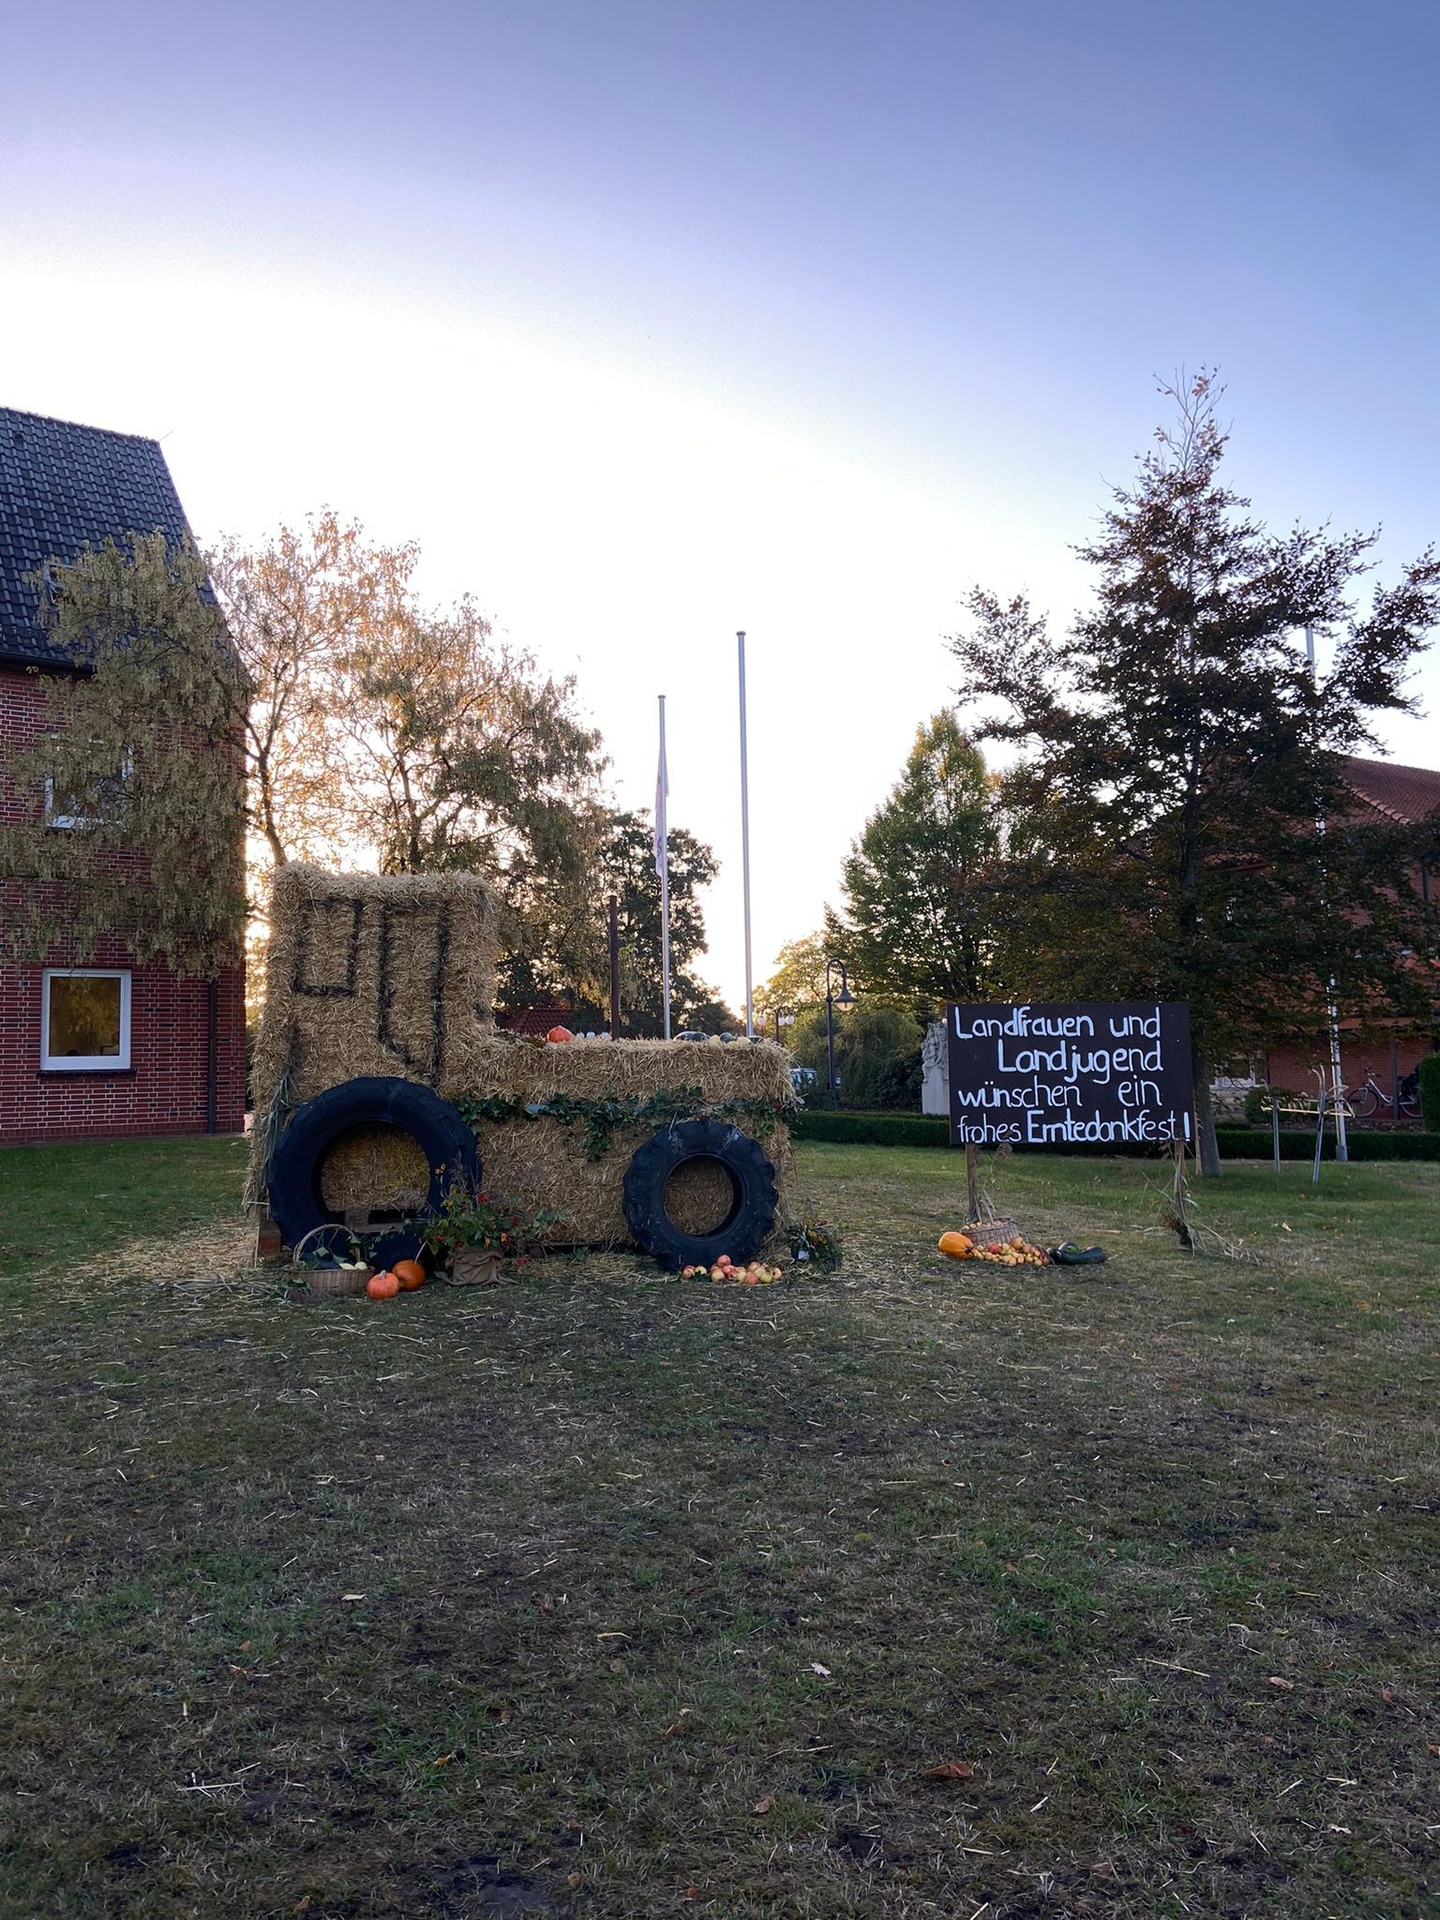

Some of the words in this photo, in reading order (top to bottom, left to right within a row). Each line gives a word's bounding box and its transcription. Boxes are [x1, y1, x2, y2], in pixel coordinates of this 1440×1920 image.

[955, 1006, 1095, 1040] Landfrauen
[1109, 1006, 1161, 1038] und
[998, 1039, 1164, 1084] Landjugend
[958, 1075, 1083, 1108] wünschen
[1117, 1075, 1163, 1107] ein
[957, 1113, 1022, 1144] frohes
[1026, 1108, 1191, 1144] Erntedankfest!
